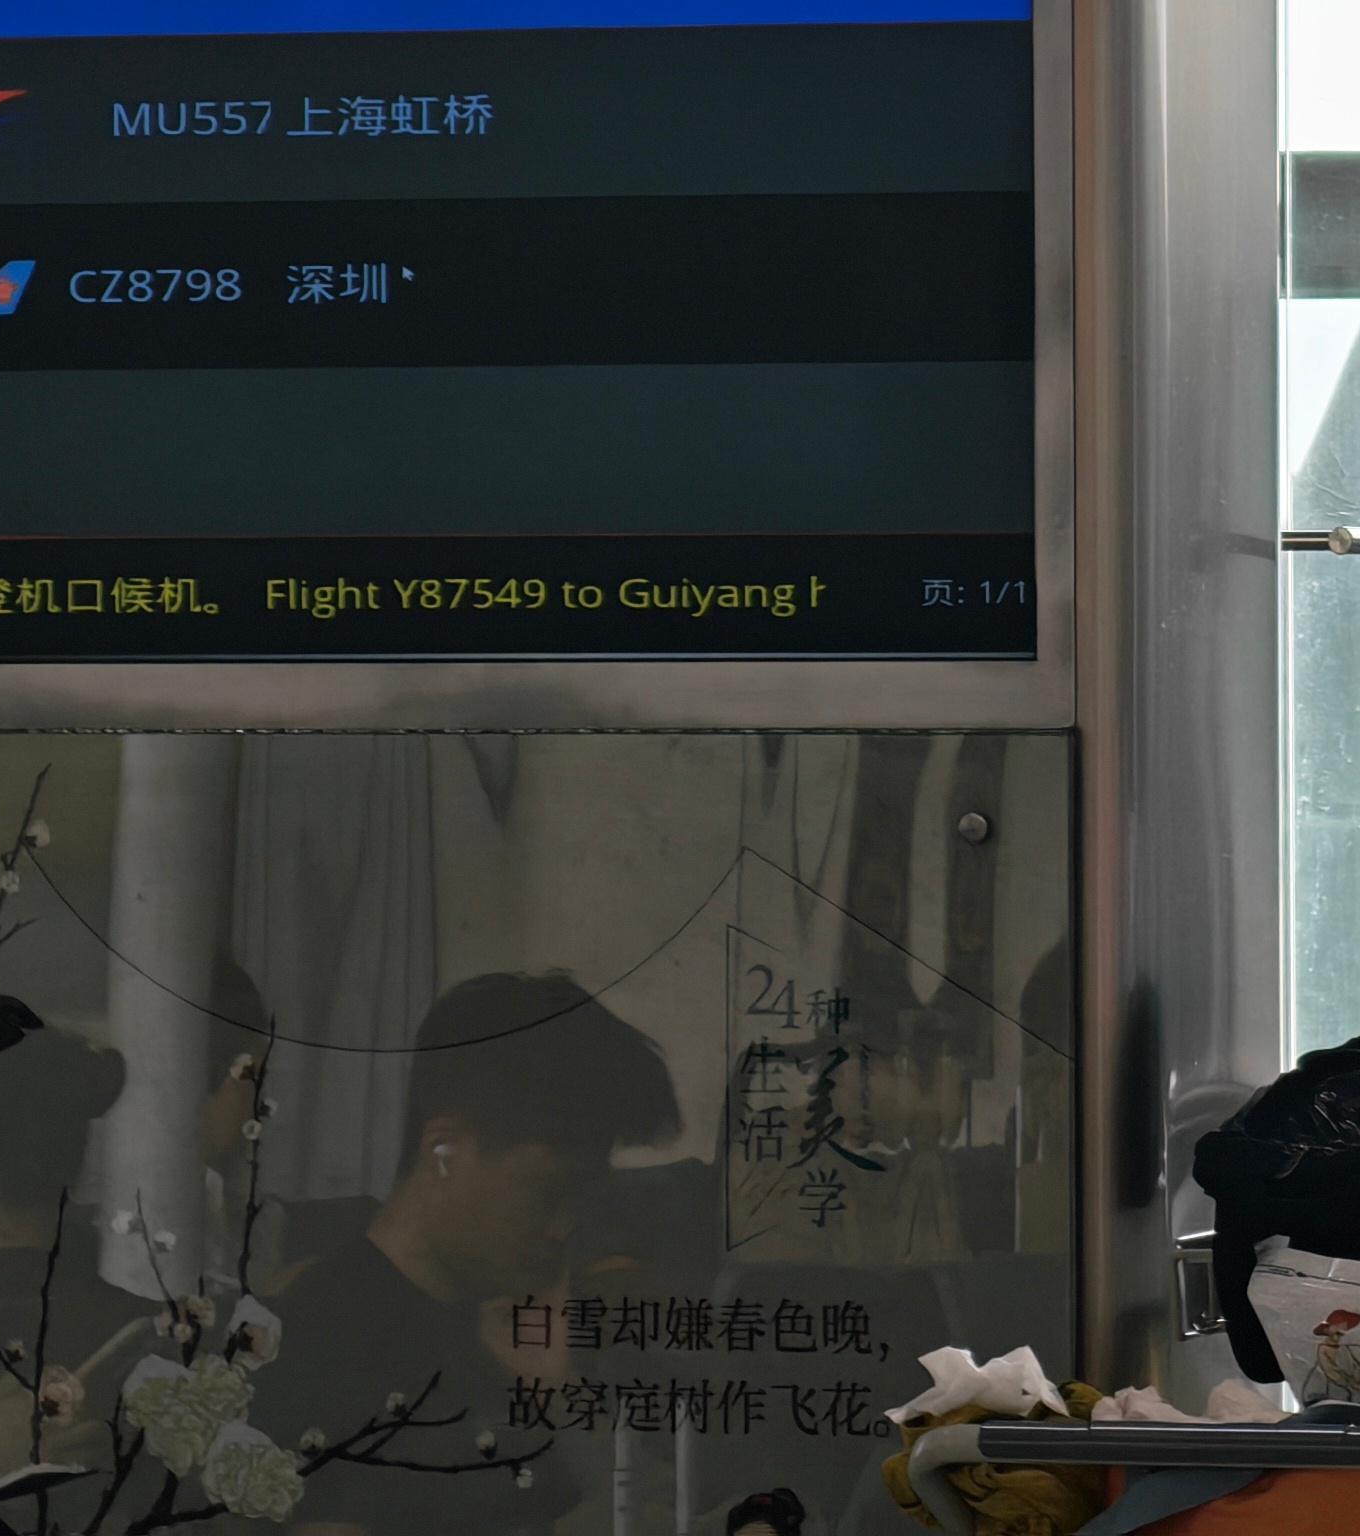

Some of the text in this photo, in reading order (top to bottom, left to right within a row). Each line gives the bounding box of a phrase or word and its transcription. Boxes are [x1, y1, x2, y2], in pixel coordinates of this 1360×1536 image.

[113, 100, 272, 137] MU557
[286, 94, 493, 137] 上海虹桥
[69, 268, 242, 303] CZ8798
[287, 262, 387, 305] 深圳
[266, 577, 380, 619] Flight
[393, 578, 546, 609] Y87549
[561, 581, 603, 609] to
[619, 577, 796, 617] Guiyang
[922, 579, 1025, 607] 页: 1/1
[739, 1036, 789, 1163] 生活
[507, 1376, 890, 1440] 故穿庭树作飞花。
